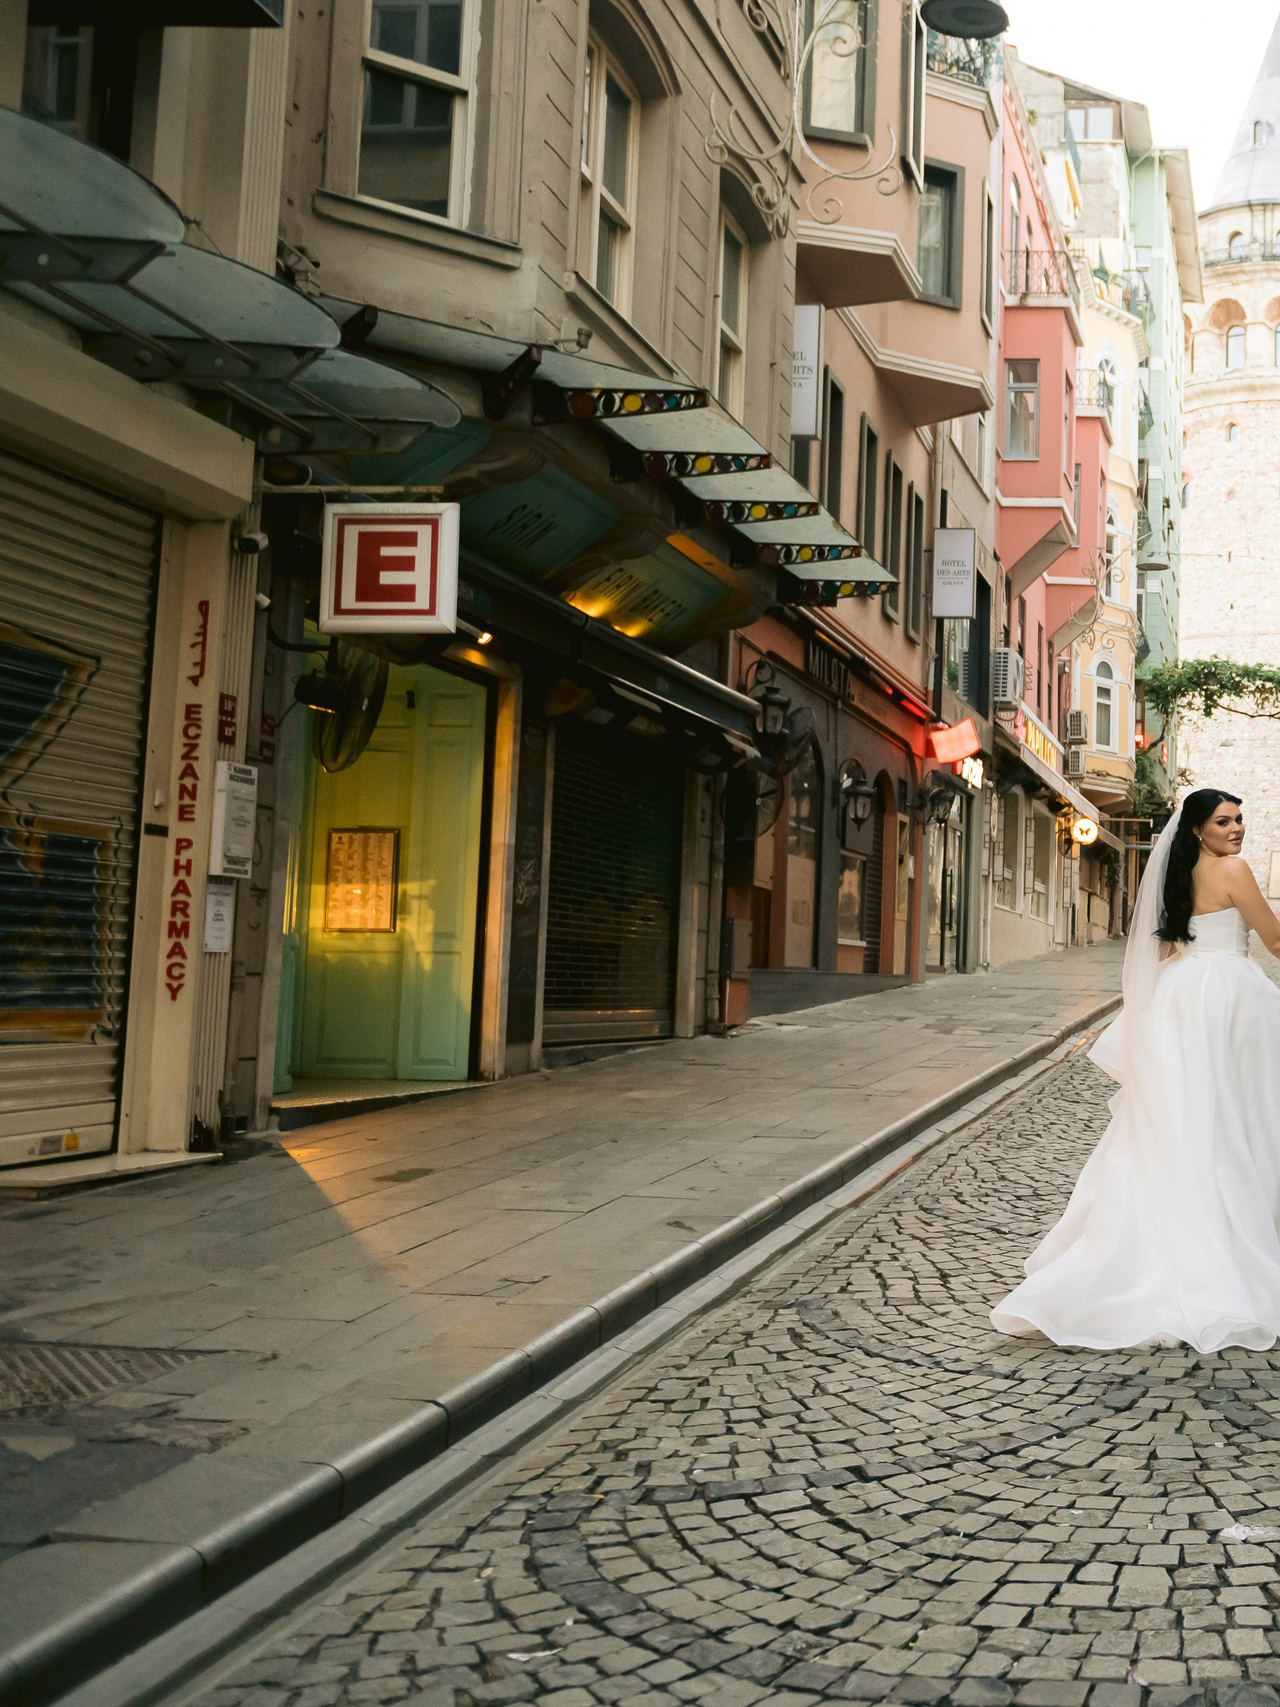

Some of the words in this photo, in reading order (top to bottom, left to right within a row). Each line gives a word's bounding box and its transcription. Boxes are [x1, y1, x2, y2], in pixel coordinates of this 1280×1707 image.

[355, 531, 418, 602] E
[941, 559, 967, 567] HOTEL
[952, 569, 971, 577] ARTS
[177, 703, 203, 822] ECZANE
[165, 838, 194, 1002] PHARMACY
